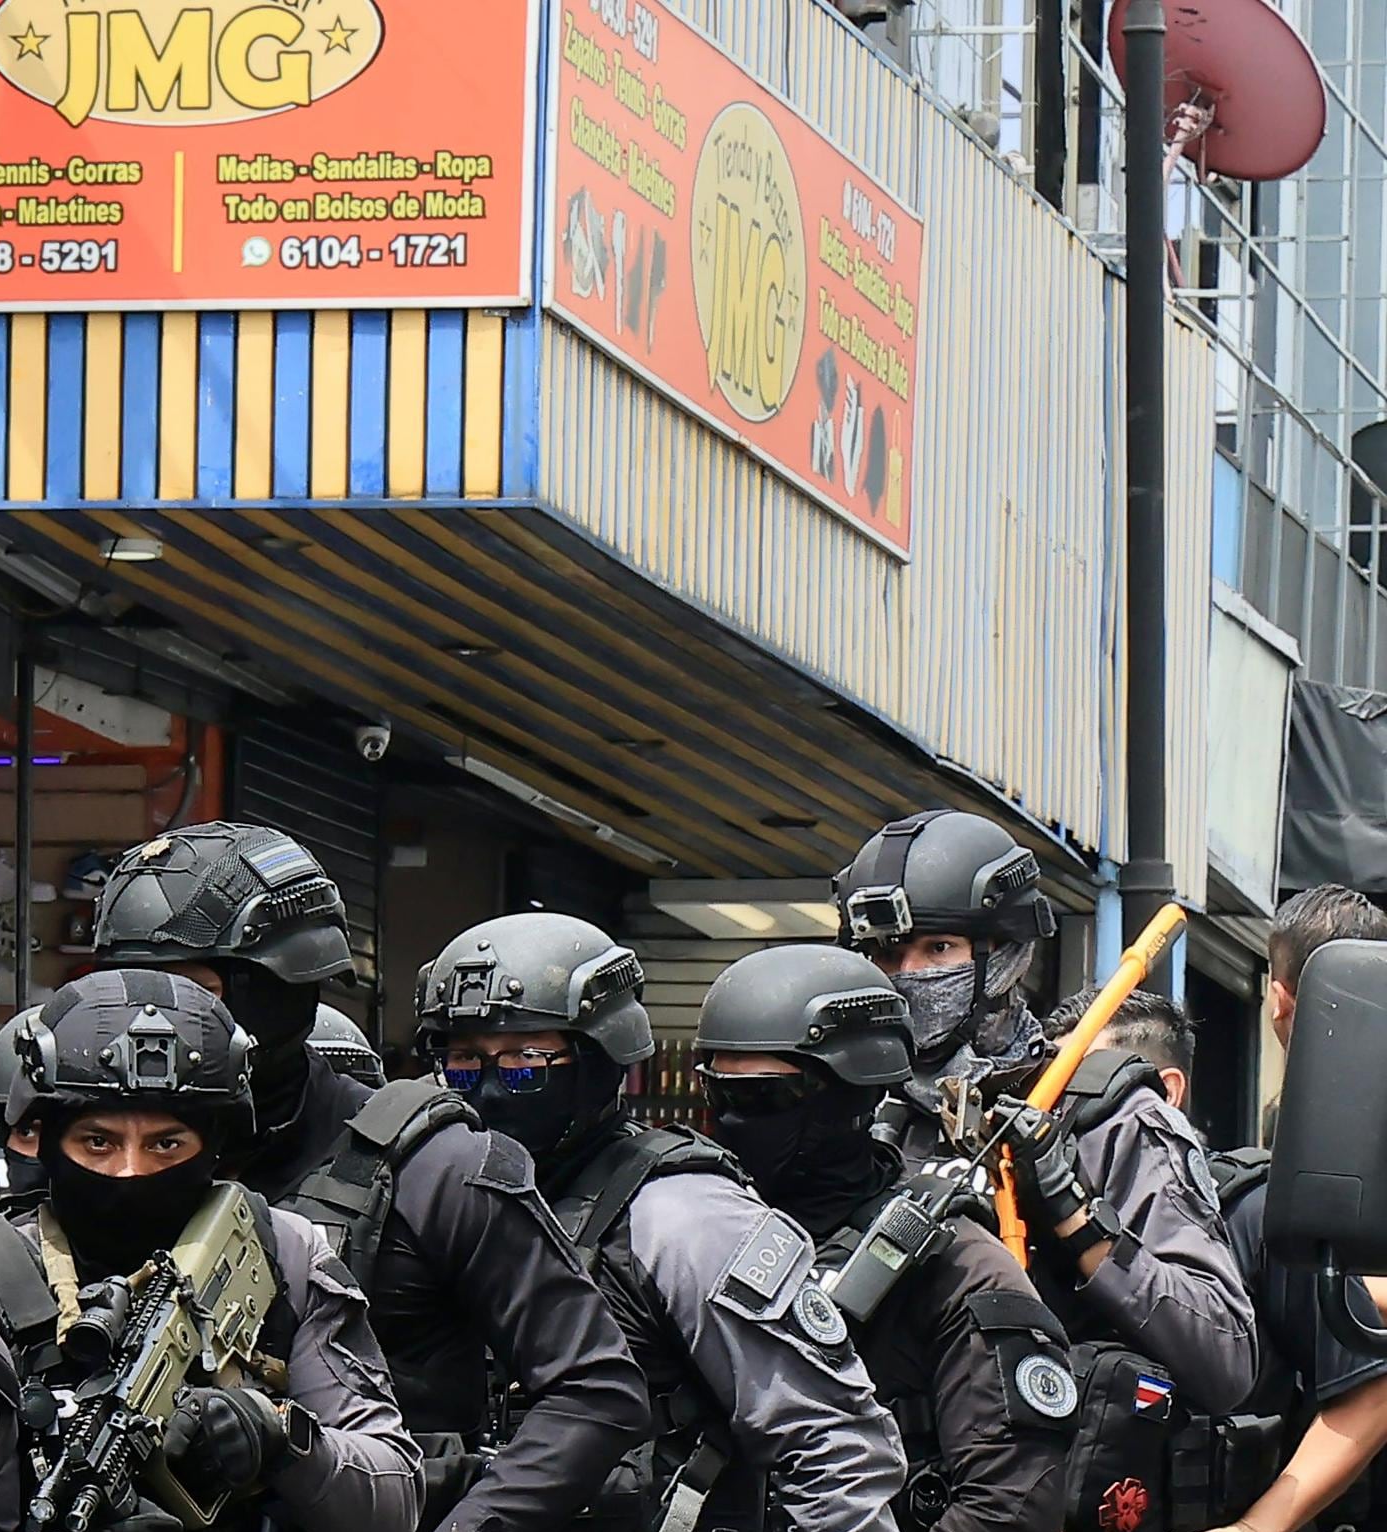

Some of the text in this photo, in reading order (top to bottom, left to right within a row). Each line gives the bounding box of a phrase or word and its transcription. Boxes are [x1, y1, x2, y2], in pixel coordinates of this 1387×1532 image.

[56, 5, 312, 128] JMG
[563, 9, 607, 88] Zapatos
[612, 49, 647, 120] Tennis
[652, 82, 687, 152] Gorras
[67, 156, 143, 185] Gorras
[217, 154, 295, 183] Medias
[312, 152, 419, 182] Sandalias
[434, 150, 493, 185] Ropa
[16, 194, 123, 226] Maletines
[223, 189, 485, 223] Todo en Bolsos de Moda
[39, 238, 119, 273] 5291
[280, 235, 362, 269] 6104
[389, 232, 468, 268] 1721
[706, 193, 787, 413] JMG
[746, 1232, 794, 1285] B.O.A.
